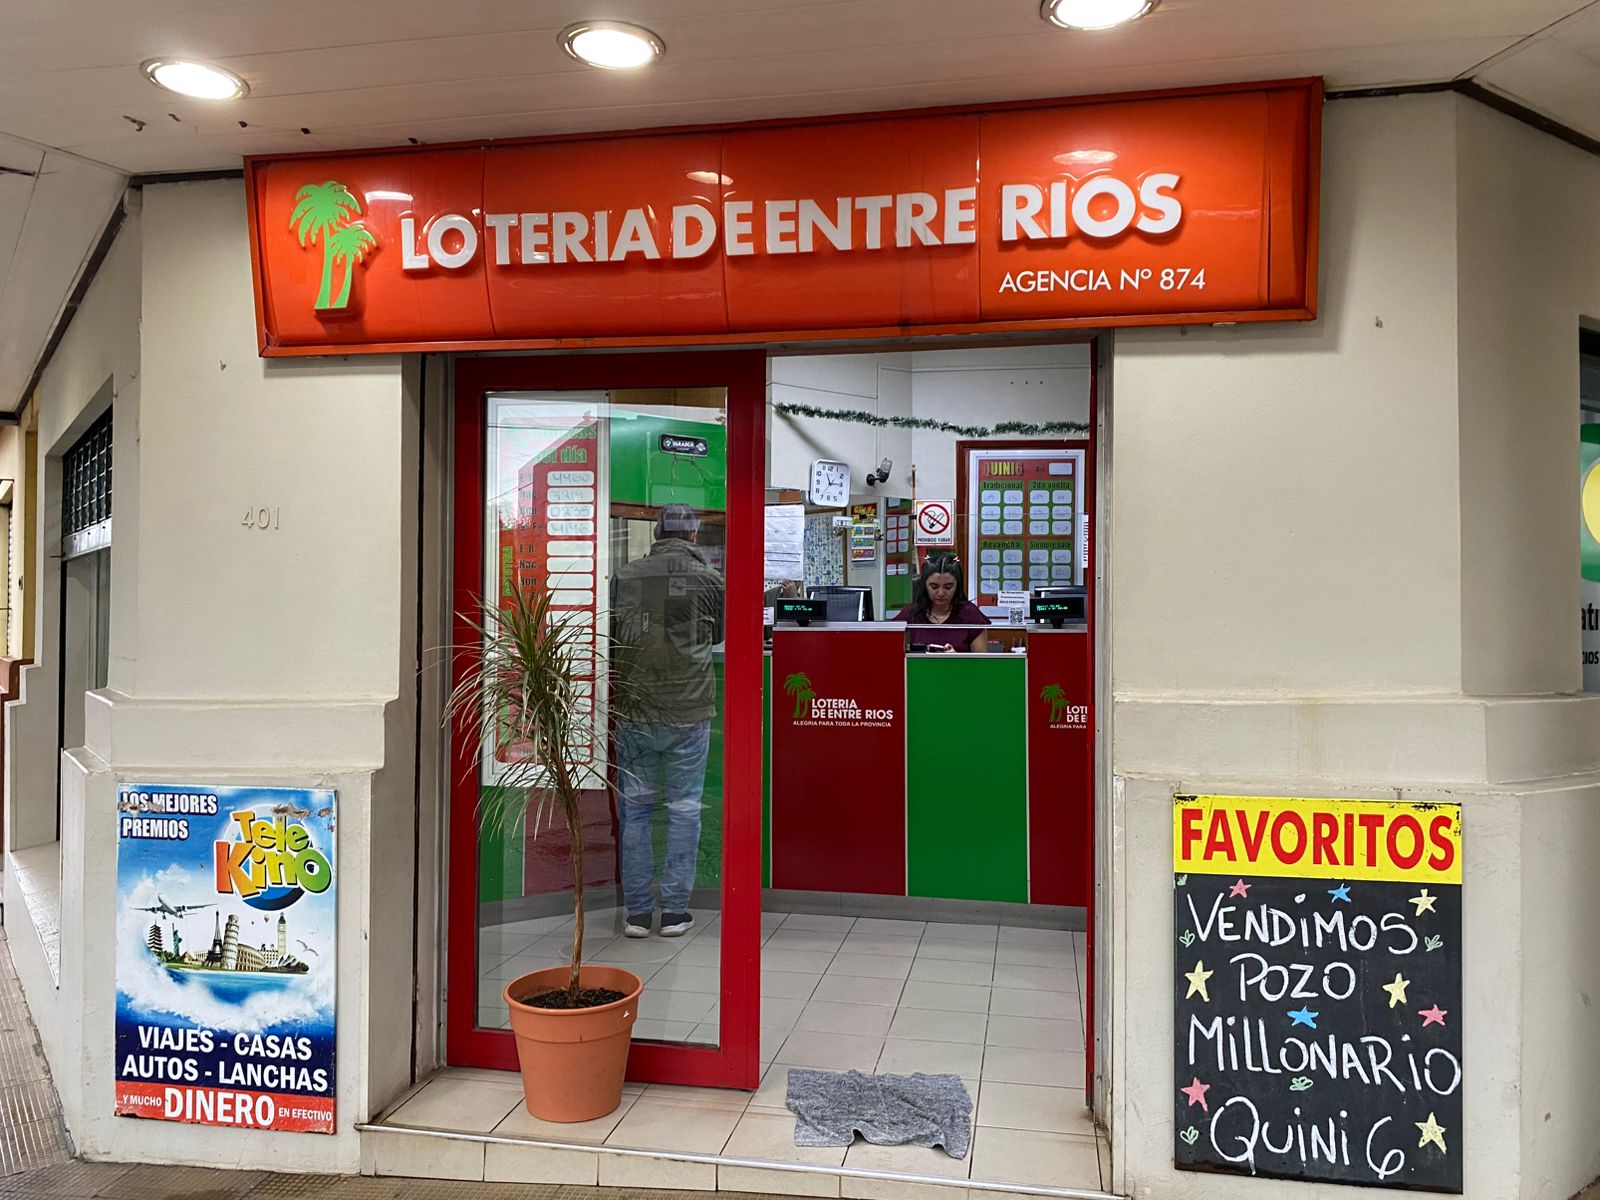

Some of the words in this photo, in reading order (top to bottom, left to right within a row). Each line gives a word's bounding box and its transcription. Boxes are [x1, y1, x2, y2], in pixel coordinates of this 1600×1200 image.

[401, 208, 661, 271] LOTERIA
[672, 200, 754, 259] DE
[765, 187, 976, 255] ENTRE
[1001, 173, 1182, 241] RIOS
[999, 269, 1112, 292] AGENCIA
[1120, 268, 1152, 291] Nº
[1159, 267, 1206, 290] 874
[983, 482, 1023, 490] Tradicional
[240, 506, 280, 530] 401
[811, 698, 858, 709] LOTERIA
[811, 708, 826, 719] DE
[827, 709, 862, 719] ENTRE
[865, 709, 893, 720] RIOS
[1066, 714, 1080, 723] DE
[120, 792, 149, 812] LOS
[151, 793, 218, 815] MEJORES
[121, 818, 189, 840] PREMIOS
[231, 809, 311, 853] Tele
[1181, 807, 1455, 872] FAVORITOS
[214, 840, 333, 898] Kino
[1229, 952, 1357, 1003] POZO
[138, 1025, 214, 1053] VIAJES
[234, 1032, 312, 1061] CASAS
[122, 1054, 198, 1082] AUTOS
[218, 1060, 329, 1092] LANCHAS
[130, 1096, 162, 1107] MUCHO
[164, 1086, 275, 1127] DINERO
[278, 1107, 290, 1117] EN
[292, 1108, 333, 1121] EFECTIVO
[1366, 1115, 1405, 1179] 6
